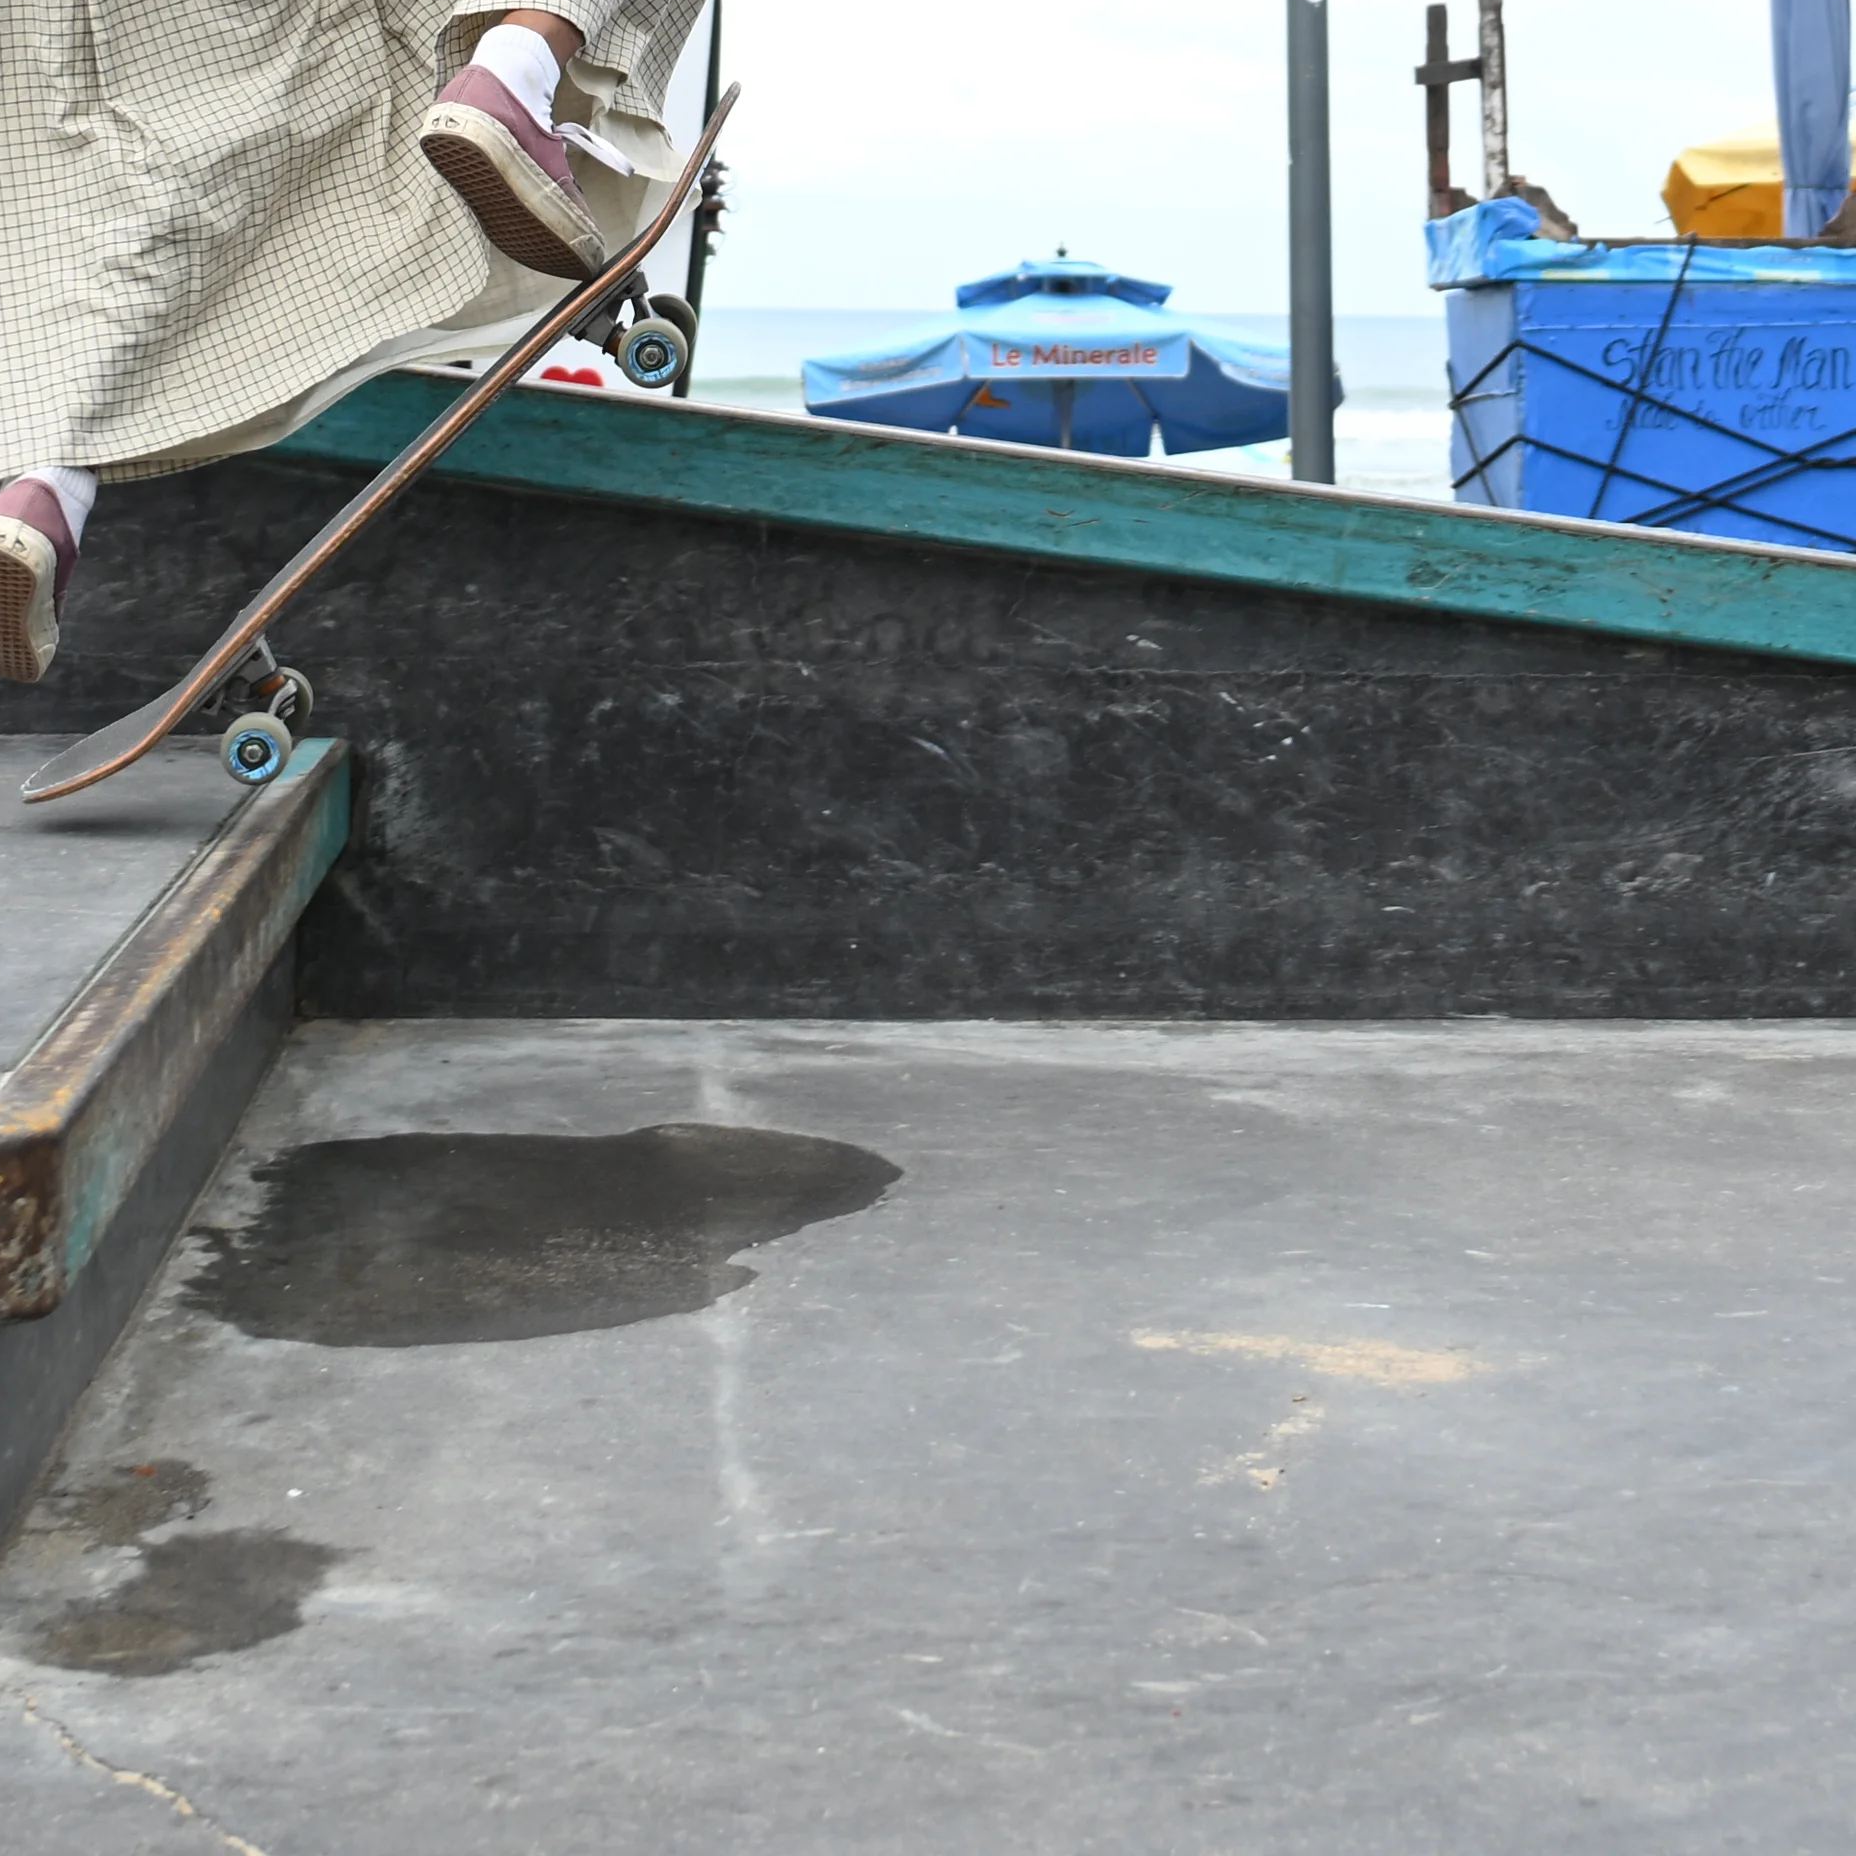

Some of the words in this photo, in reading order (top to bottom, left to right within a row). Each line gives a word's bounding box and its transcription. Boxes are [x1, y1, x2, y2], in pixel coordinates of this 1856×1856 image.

[991, 343, 1022, 366] Le
[1032, 341, 1157, 366] Minerale
[1770, 337, 1856, 390] Man
